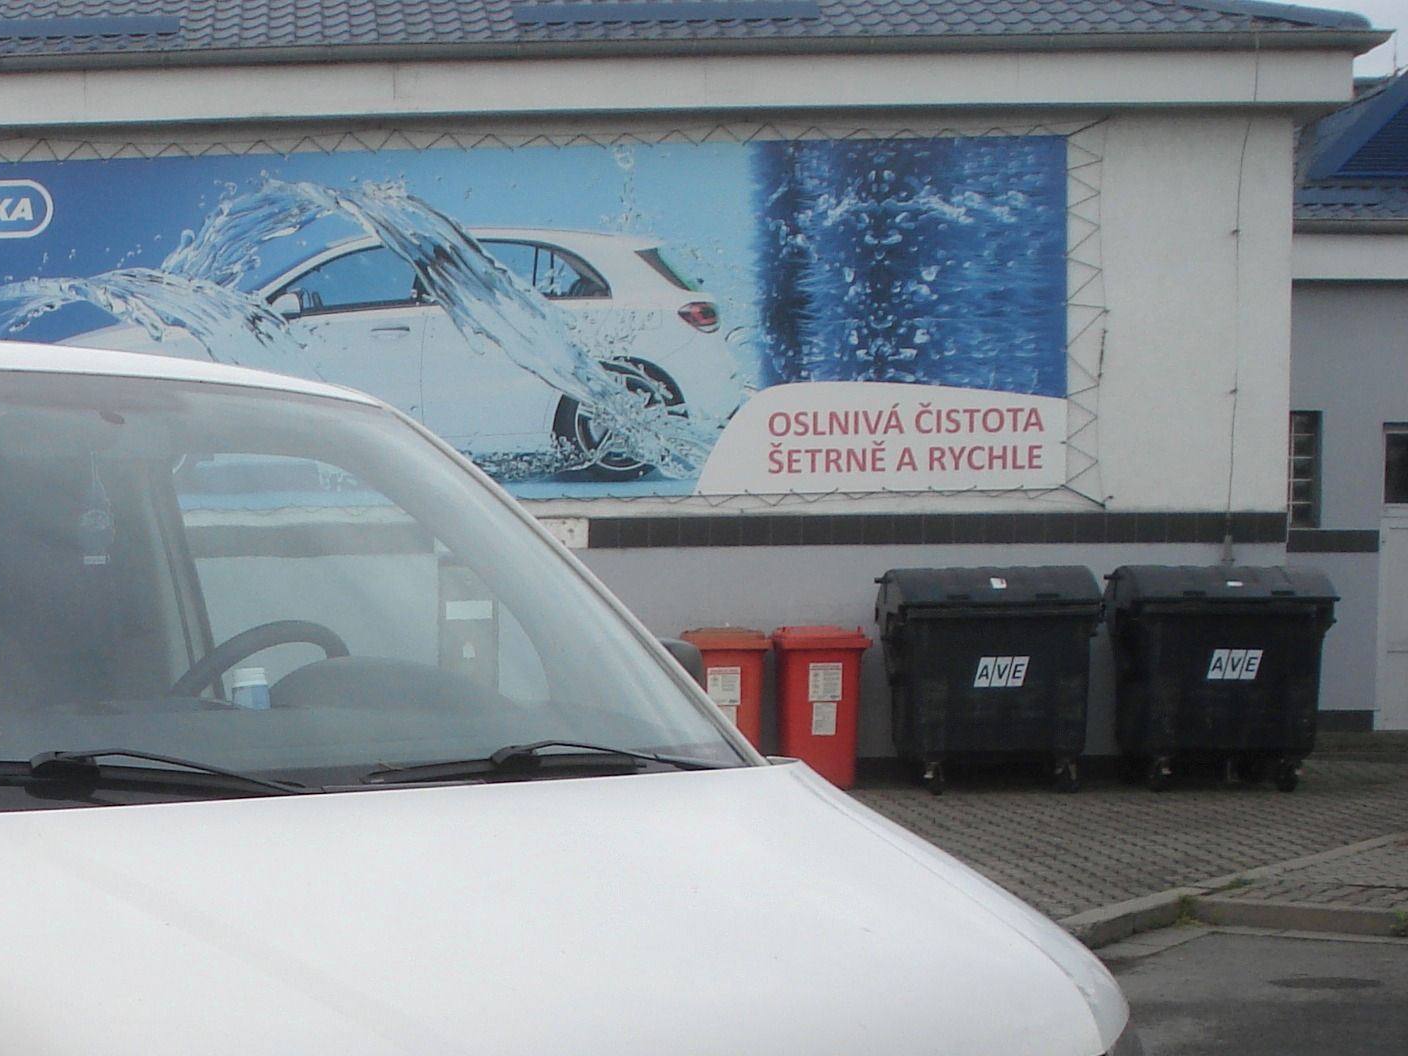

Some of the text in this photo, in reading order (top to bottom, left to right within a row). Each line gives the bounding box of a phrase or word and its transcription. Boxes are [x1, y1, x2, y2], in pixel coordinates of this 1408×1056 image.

[768, 402, 1045, 437] OSLNIVÁ ČISTOTA
[768, 441, 1044, 474] ŠETRNĚ A RYCHLE
[977, 662, 1026, 681] AVE
[1211, 654, 1260, 673] AVE
